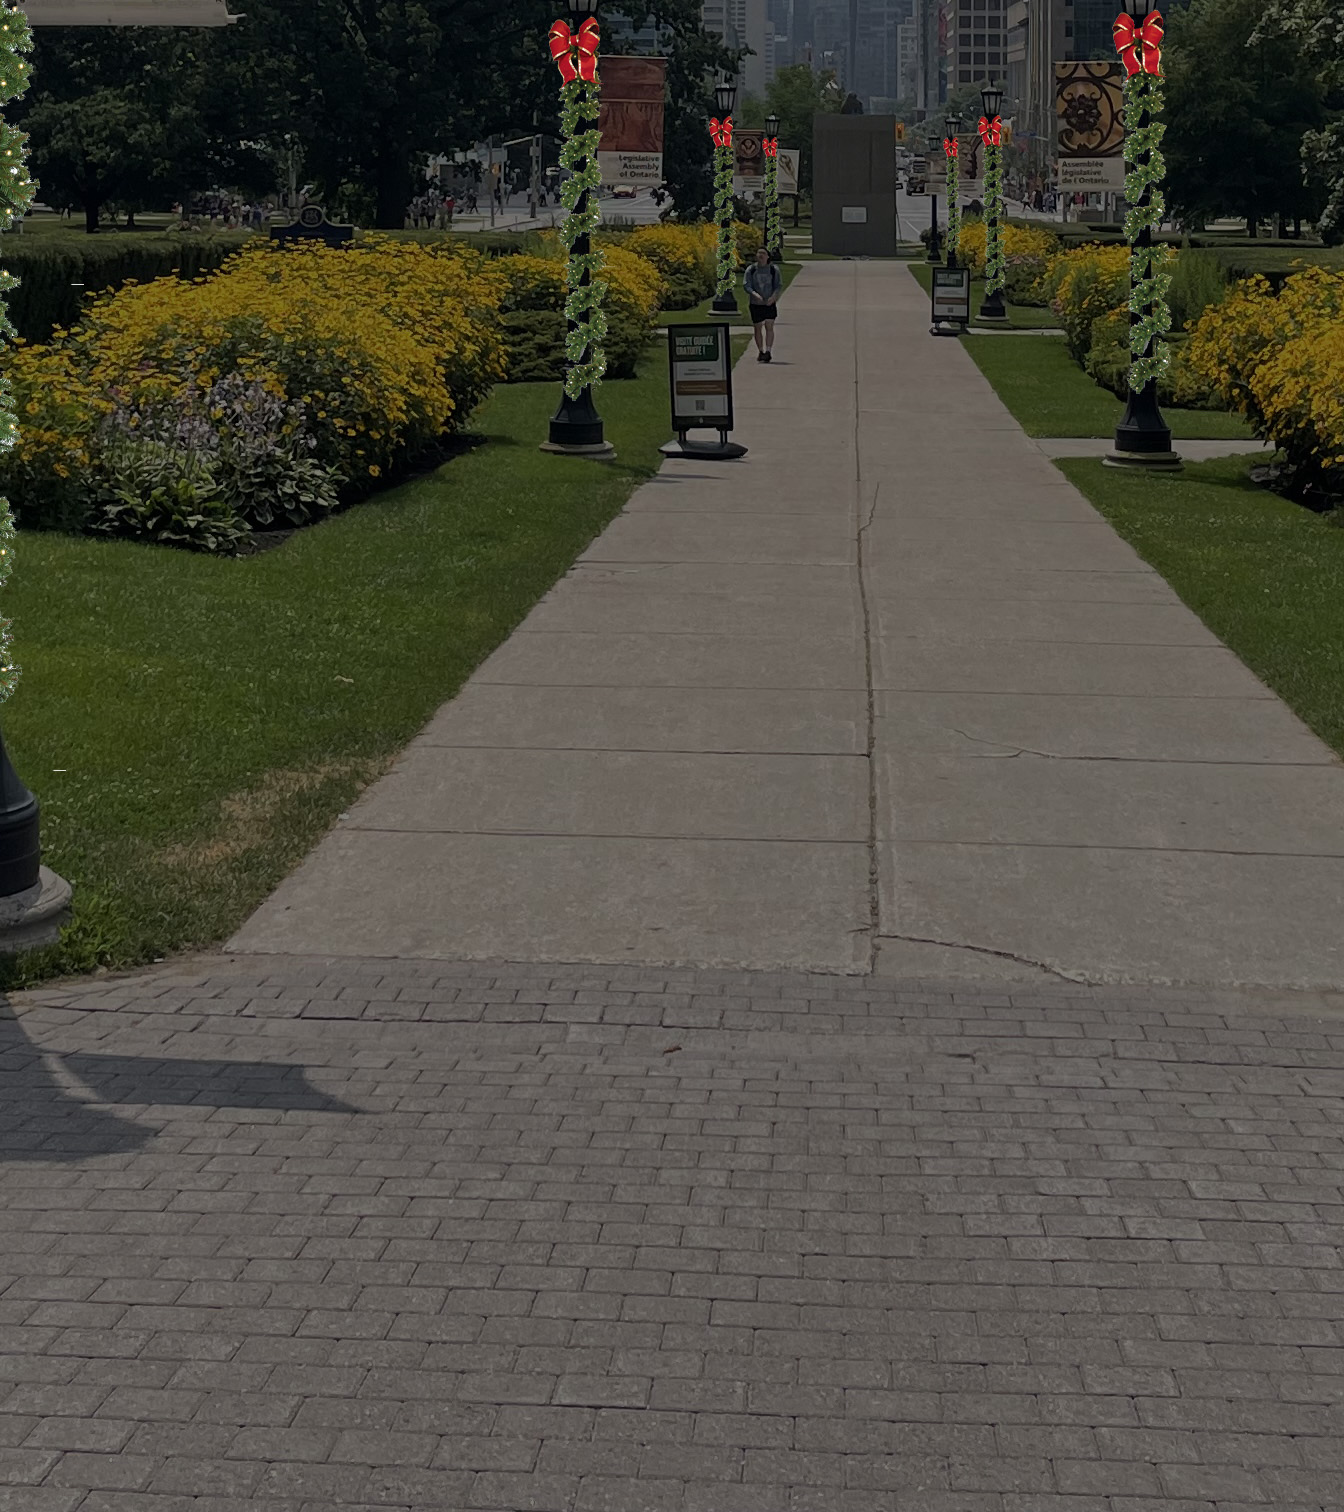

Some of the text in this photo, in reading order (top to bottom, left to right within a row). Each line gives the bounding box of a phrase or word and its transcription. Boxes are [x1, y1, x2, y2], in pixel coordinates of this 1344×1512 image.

[618, 154, 660, 163] Legislative
[622, 162, 660, 171] Assembly
[619, 170, 660, 178] of Ontario
